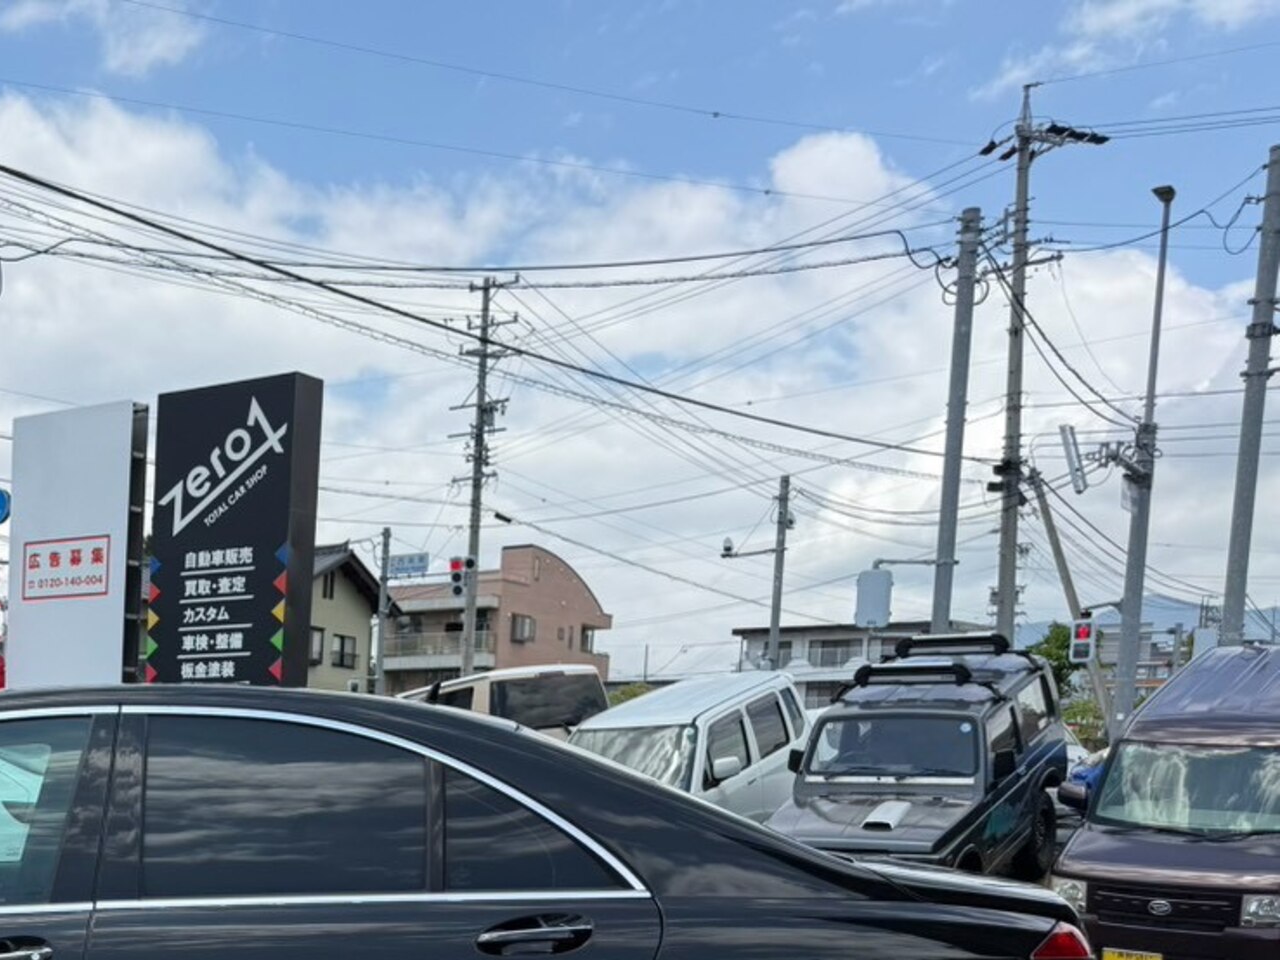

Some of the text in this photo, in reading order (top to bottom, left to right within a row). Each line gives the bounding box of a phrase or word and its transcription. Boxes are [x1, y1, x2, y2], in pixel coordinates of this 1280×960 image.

[203, 464, 268, 527] TOTAL CAR SHOP
[184, 547, 254, 569] 自動車販売
[183, 605, 230, 624] カスタム
